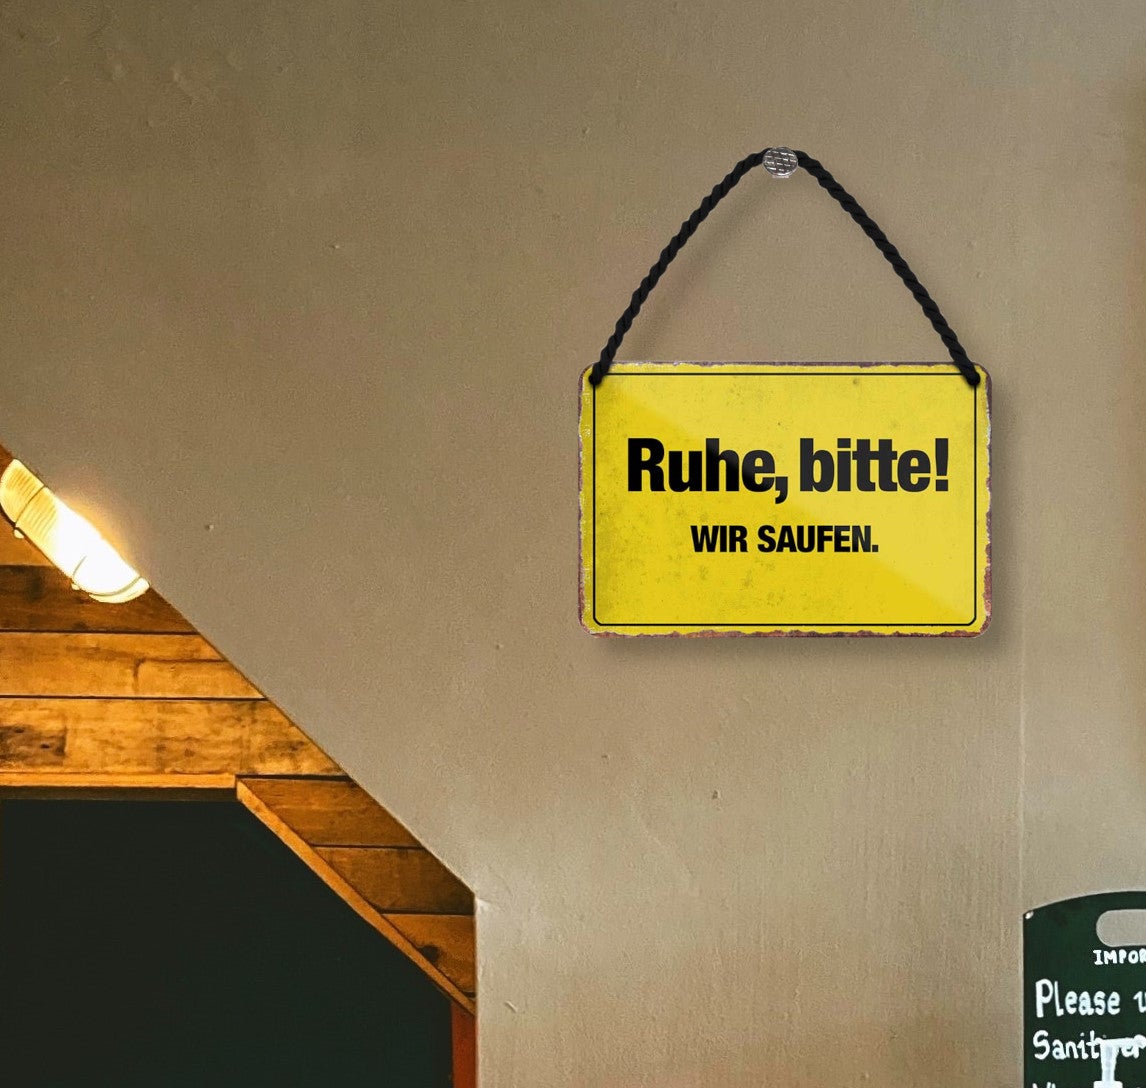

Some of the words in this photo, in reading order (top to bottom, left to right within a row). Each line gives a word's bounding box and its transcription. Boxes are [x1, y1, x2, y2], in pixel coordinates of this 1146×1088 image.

[627, 437, 789, 505] Ruhe,
[799, 437, 950, 493] bitte!
[690, 525, 748, 554] WIR
[757, 524, 879, 554] SAUFEN.
[1035, 978, 1121, 1018] Please
